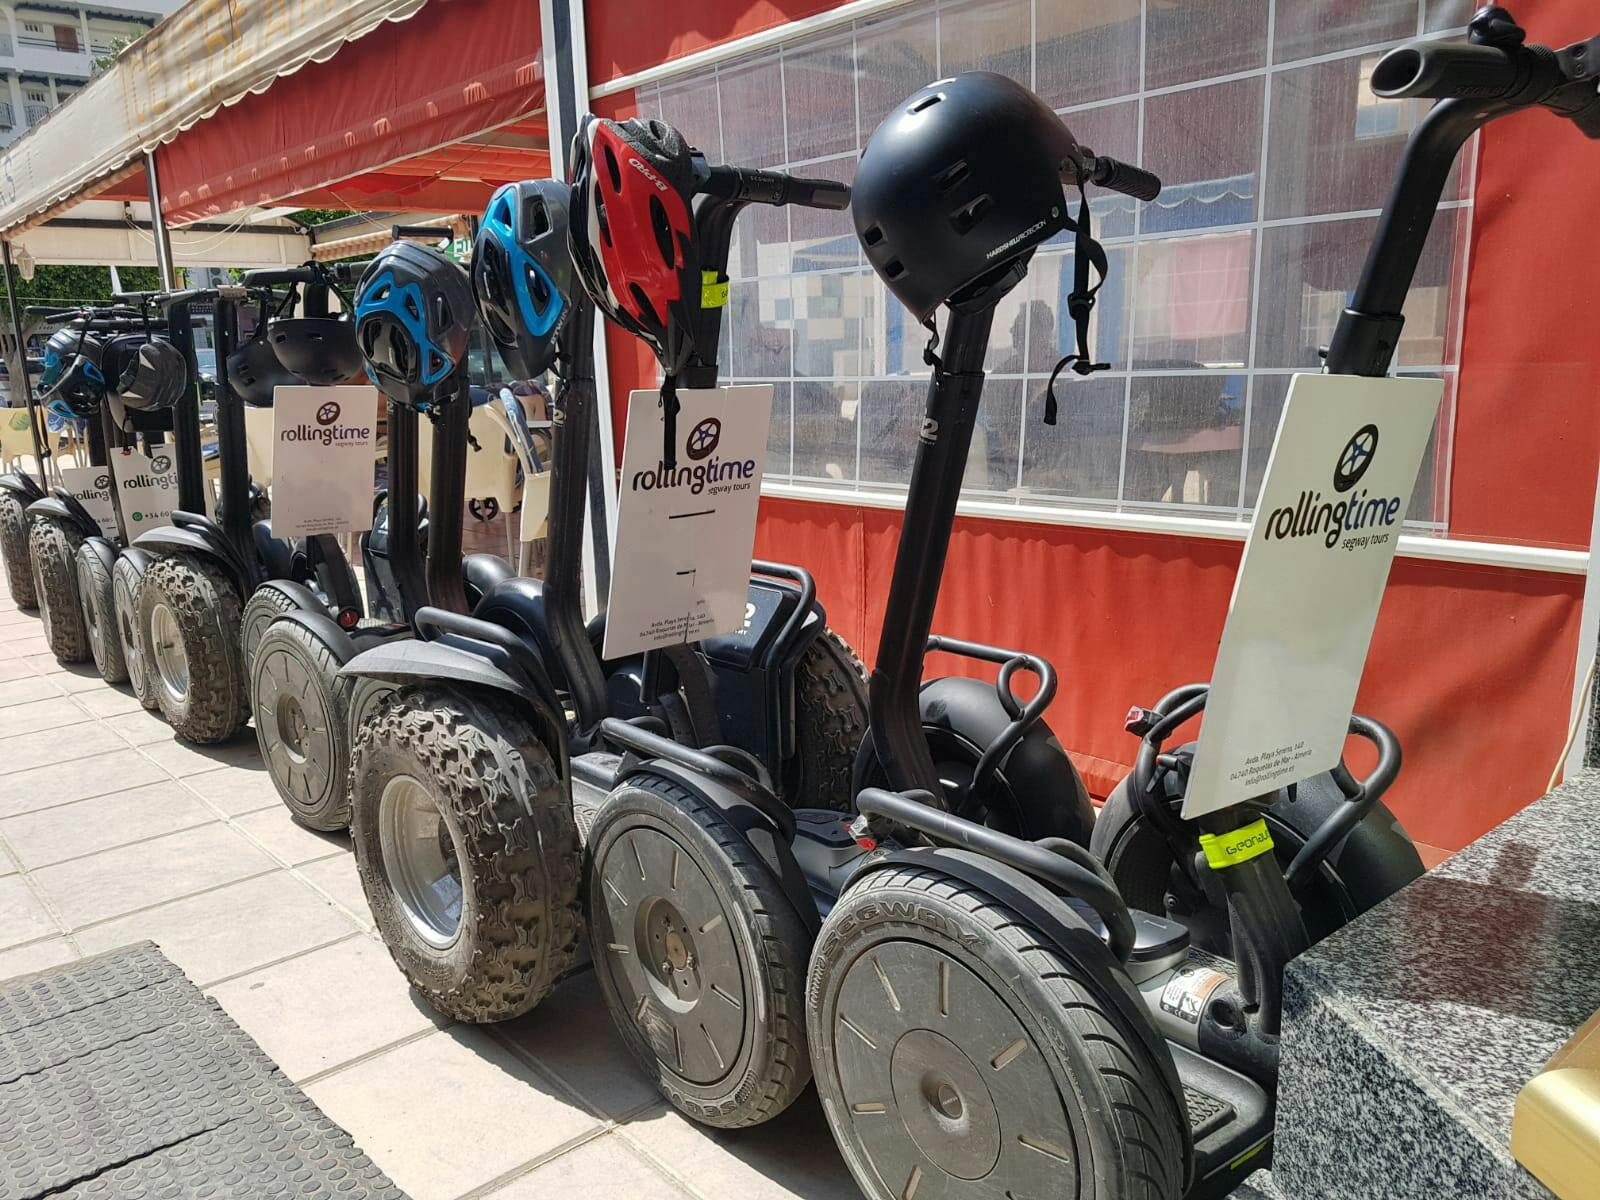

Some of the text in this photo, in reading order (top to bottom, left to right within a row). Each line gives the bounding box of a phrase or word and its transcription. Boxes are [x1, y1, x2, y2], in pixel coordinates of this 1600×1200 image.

[281, 424, 371, 447] rollingtime
[632, 456, 756, 495] rollingtime
[707, 482, 752, 496] segway tours
[1264, 489, 1401, 549] rollingtime
[1341, 533, 1389, 551] segway tours
[823, 901, 988, 960] SEGWAY
